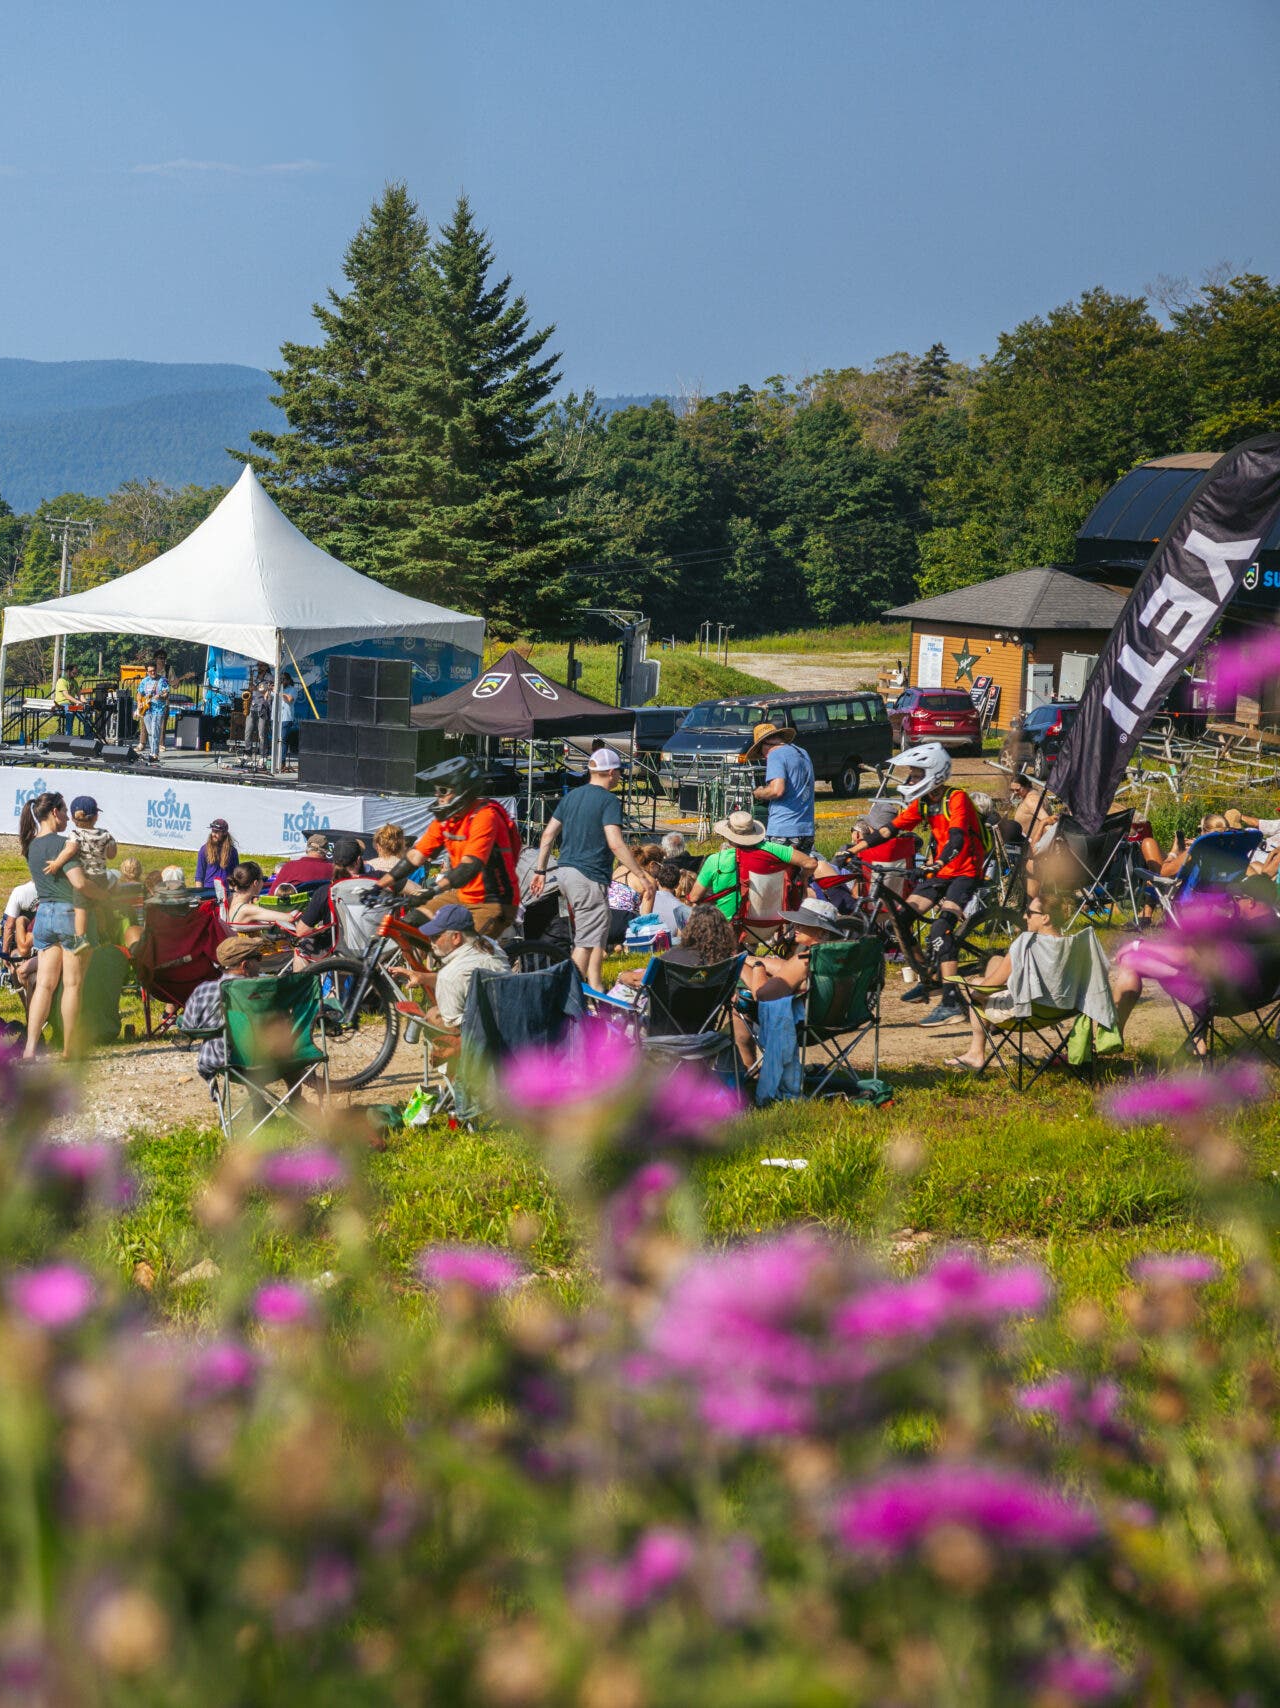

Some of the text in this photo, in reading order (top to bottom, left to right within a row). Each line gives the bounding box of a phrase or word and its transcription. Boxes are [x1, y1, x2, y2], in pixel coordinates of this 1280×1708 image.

[1102, 529, 1262, 735] YETI
[16, 789, 38, 806] KO
[147, 799, 192, 820] KONA
[146, 817, 192, 831] BIG WAVE
[283, 813, 330, 831] KONA
